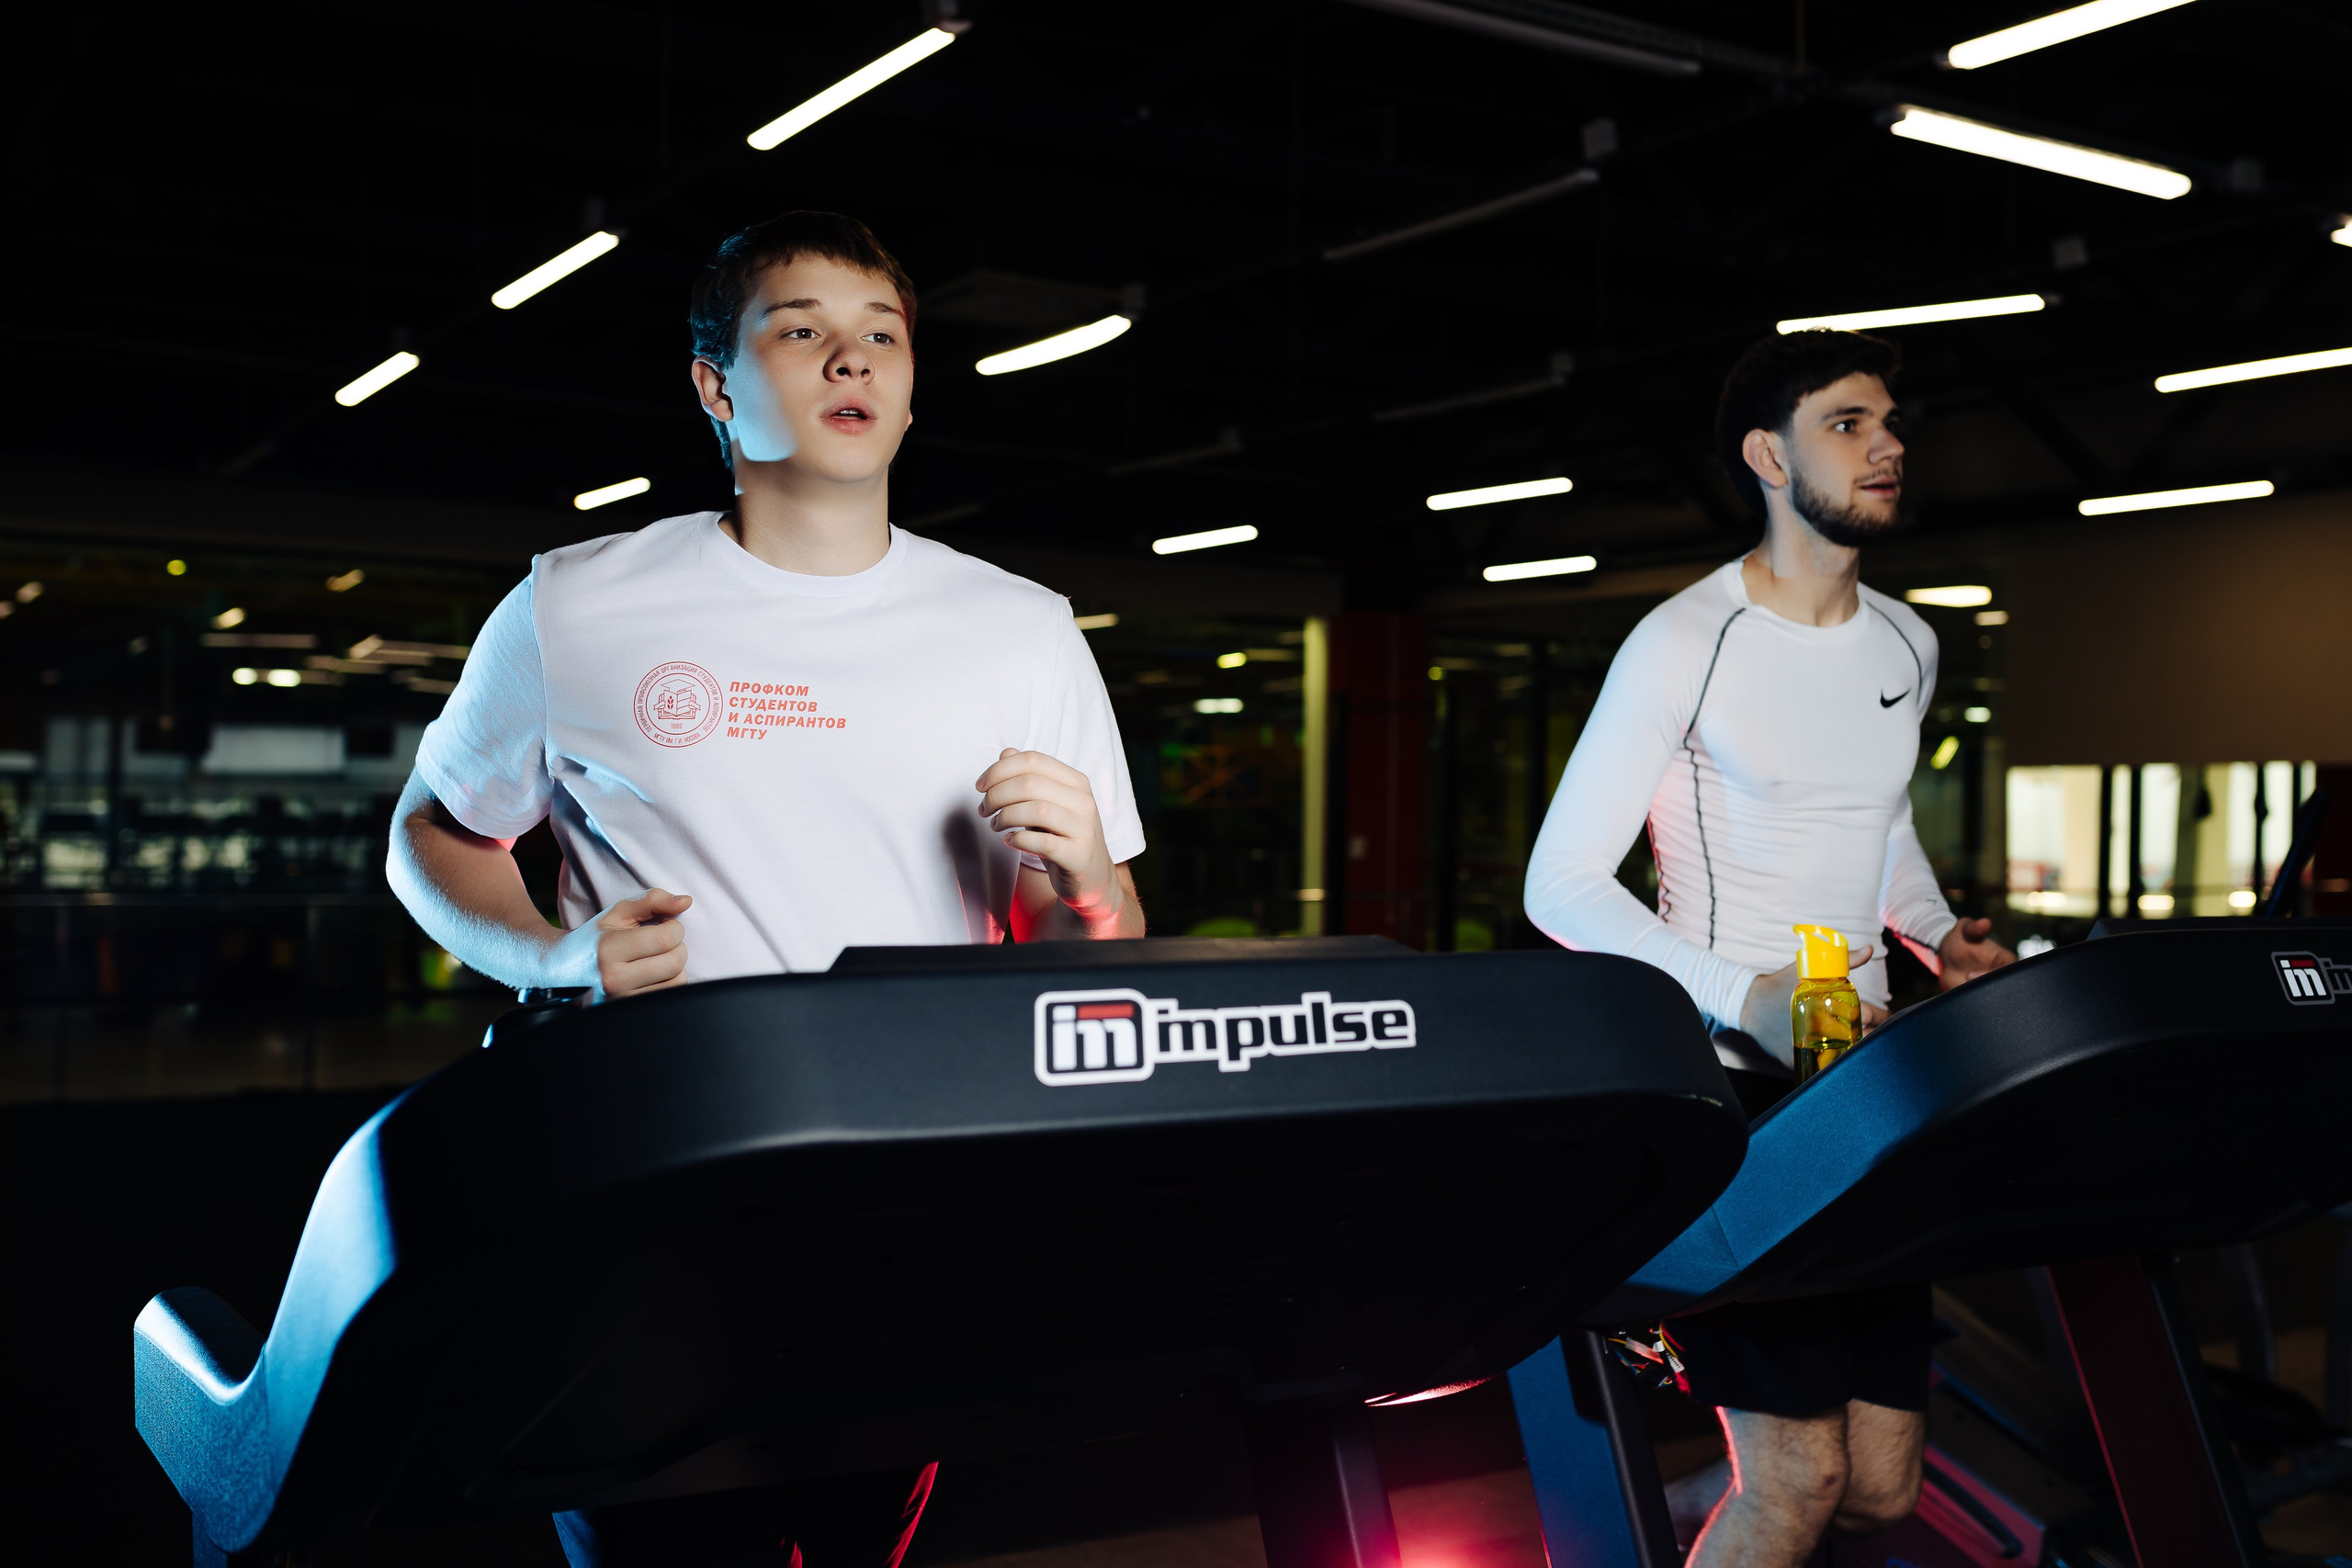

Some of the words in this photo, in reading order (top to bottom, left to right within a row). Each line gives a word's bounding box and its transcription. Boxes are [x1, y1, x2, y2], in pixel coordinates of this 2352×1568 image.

[662, 664, 697, 673] ОРГАНИЗАЦИЯ
[698, 671, 718, 695] СТУДЕНТОВ
[729, 682, 808, 696] ПРОФКОМ
[729, 696, 818, 712] СТУДЕНТОВ
[728, 712, 739, 723] И
[743, 714, 846, 728] АСПИРАНТОВ
[727, 727, 767, 739] МГТУ
